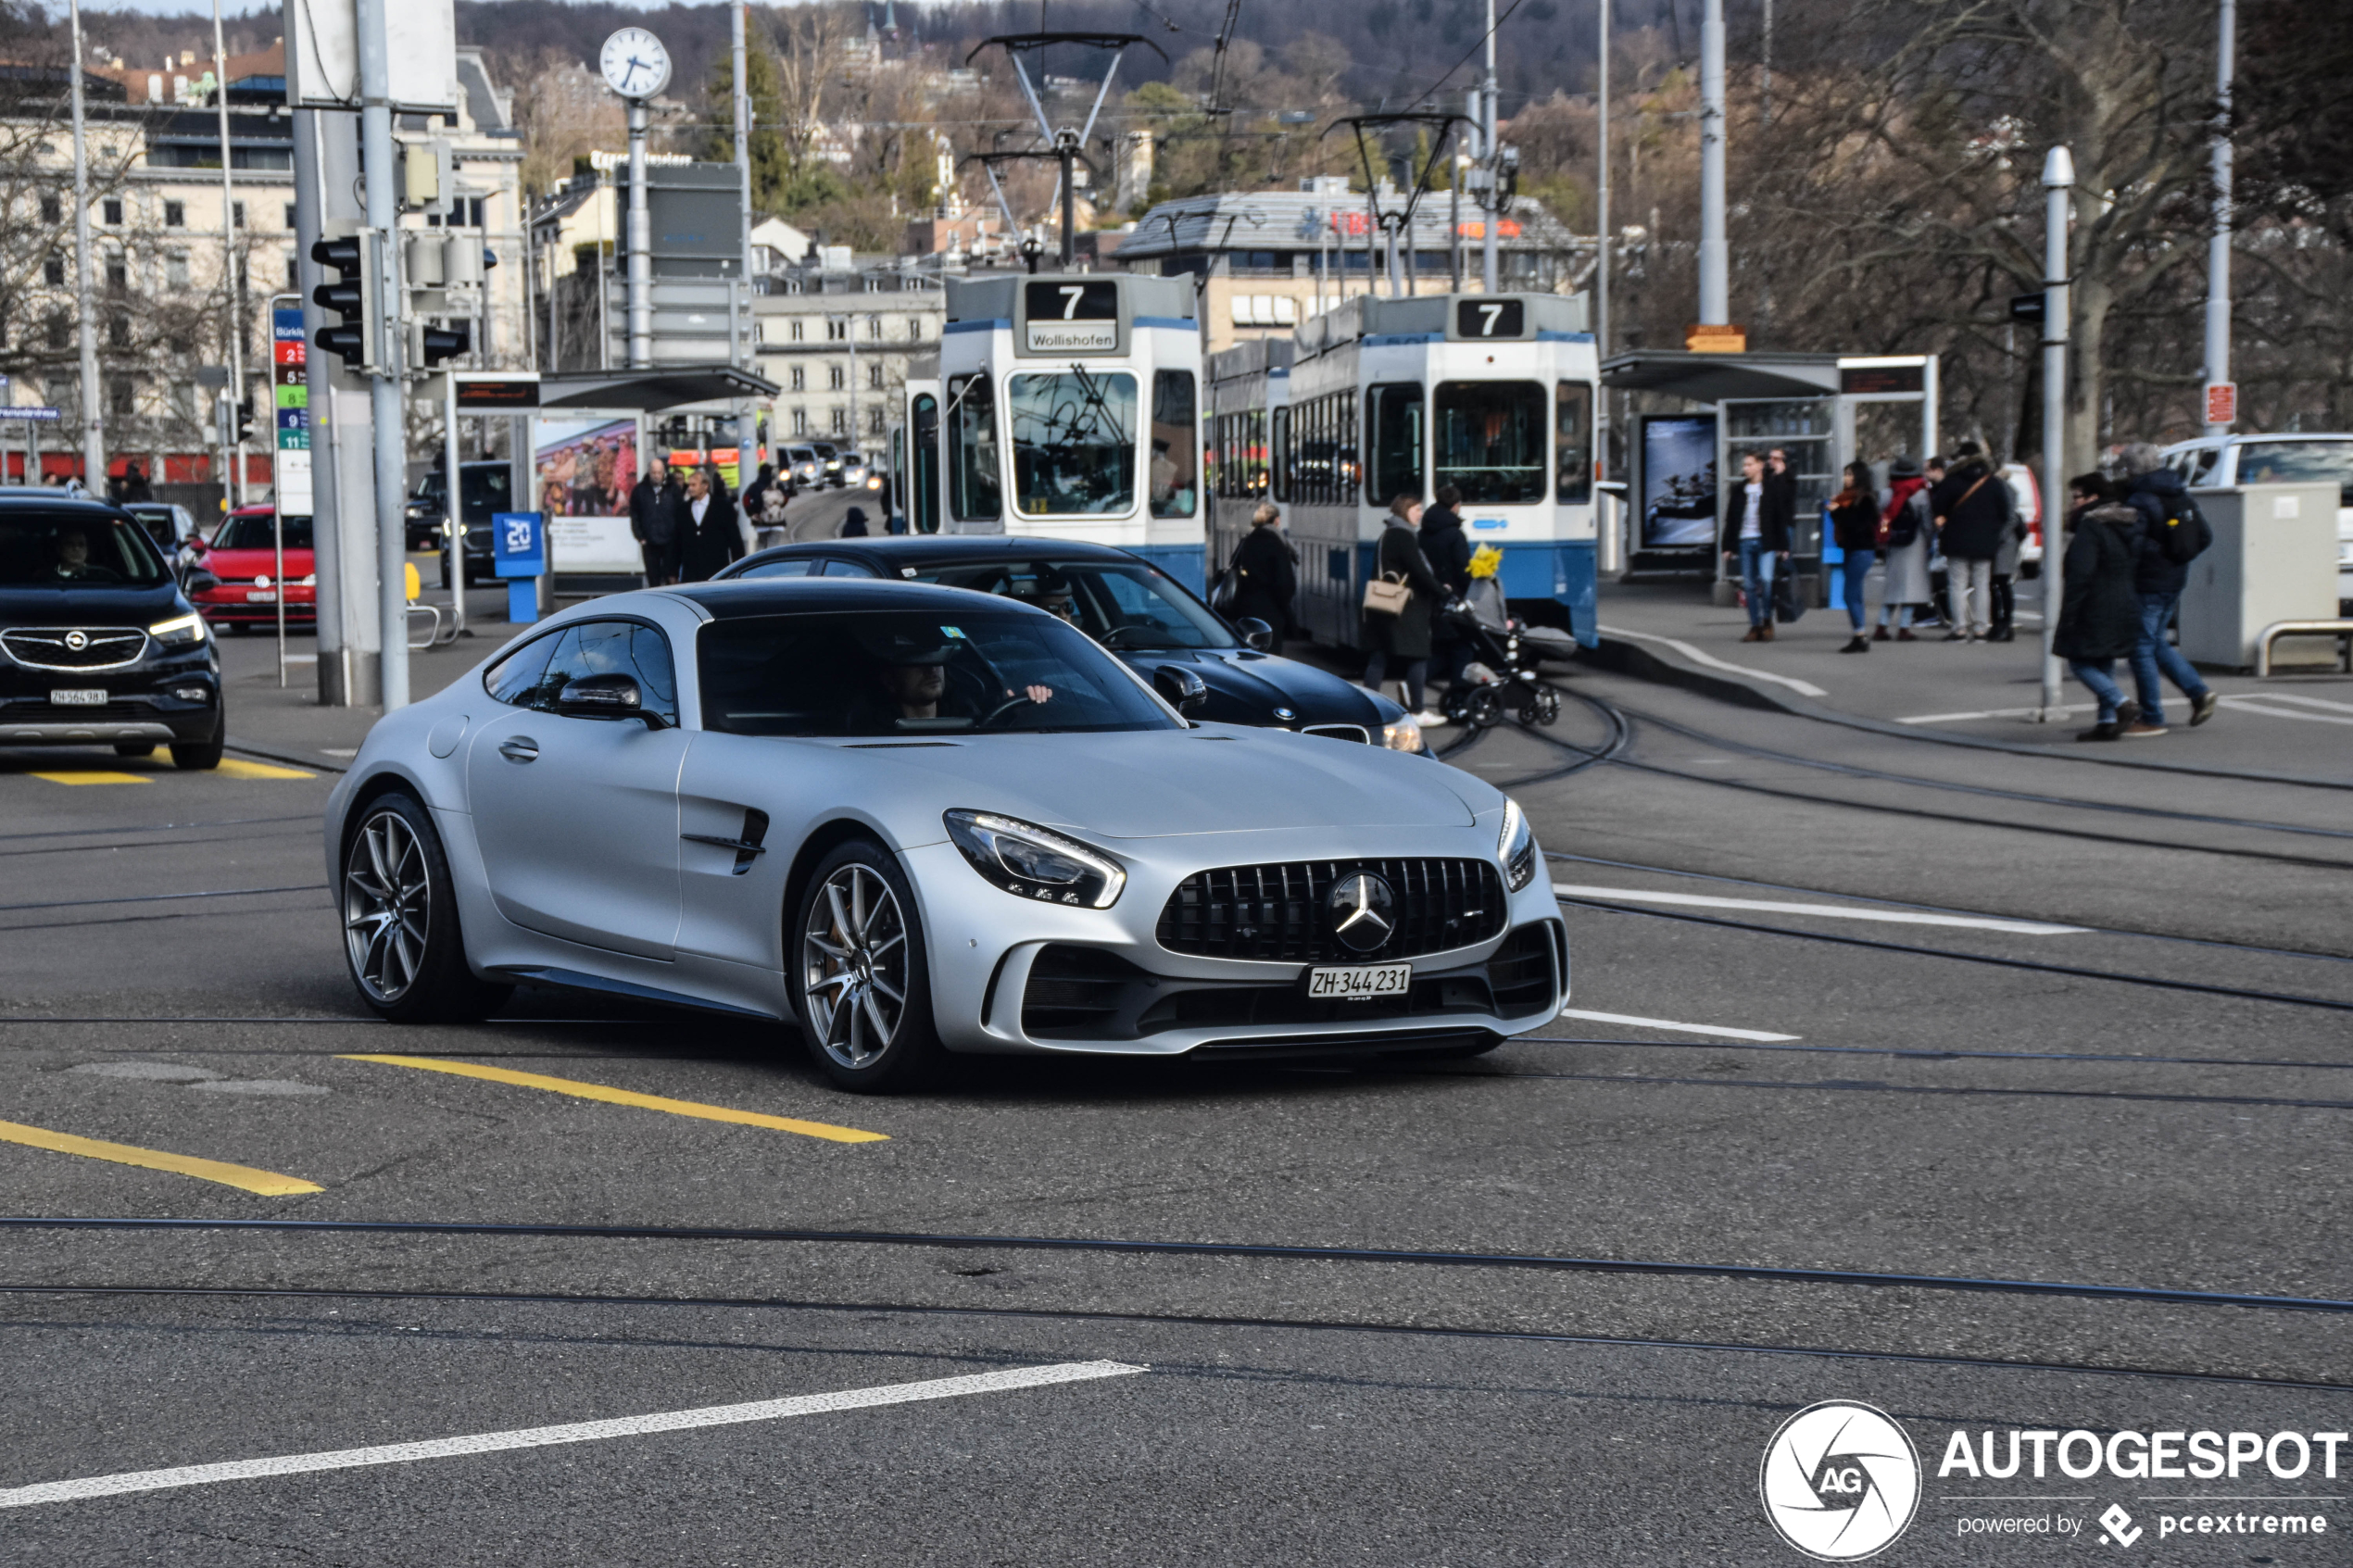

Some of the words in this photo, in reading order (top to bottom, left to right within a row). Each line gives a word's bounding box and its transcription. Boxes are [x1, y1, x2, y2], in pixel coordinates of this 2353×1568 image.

[1059, 286, 1084, 320] 7
[1478, 304, 1503, 336] 7
[1033, 334, 1113, 346] Wollishofen
[286, 348, 296, 363] 2
[287, 370, 297, 384] 5
[288, 393, 296, 405] 8
[288, 414, 298, 428] 9
[285, 436, 299, 449] 11
[507, 521, 532, 546] 20
[1375, 969, 1406, 992] 231
